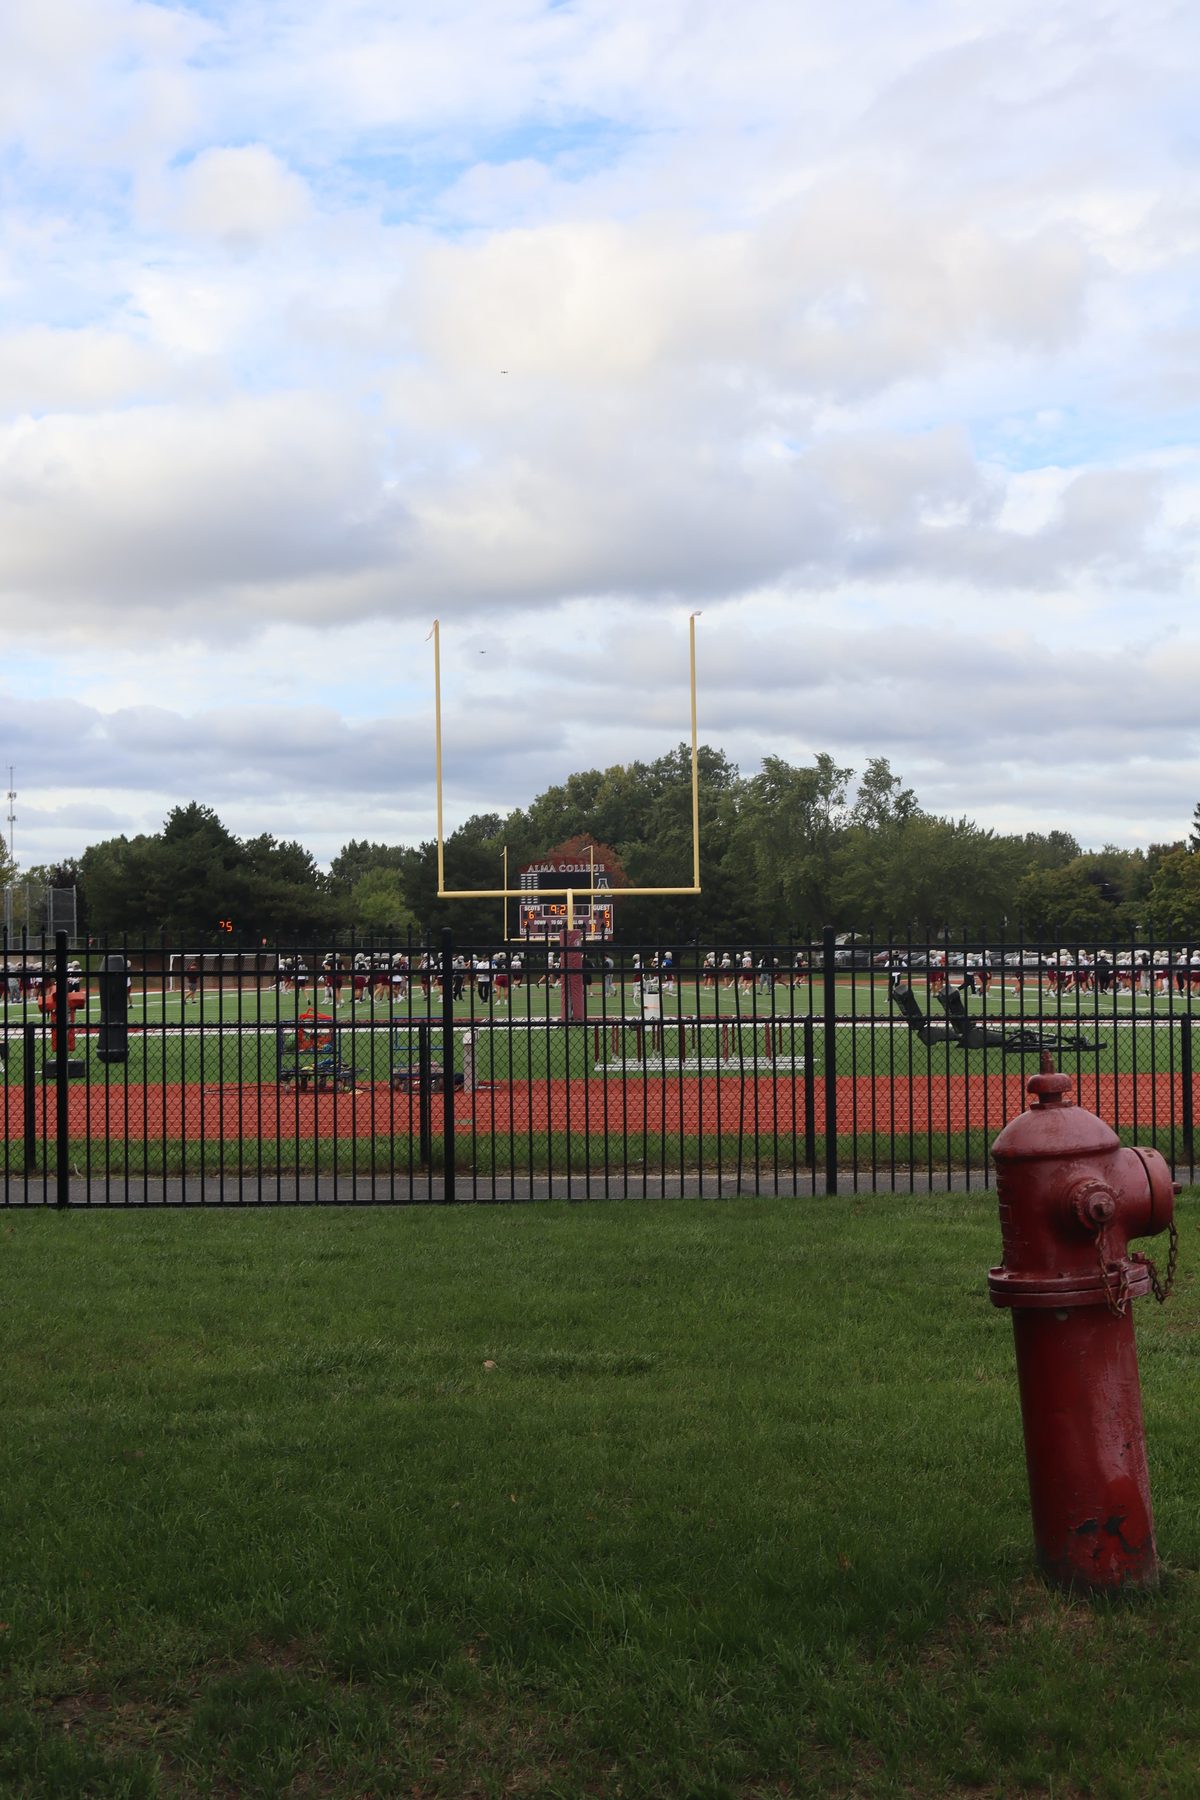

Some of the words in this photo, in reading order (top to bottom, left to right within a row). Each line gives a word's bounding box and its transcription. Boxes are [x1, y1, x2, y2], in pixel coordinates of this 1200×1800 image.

[527, 864, 556, 873] ALMA
[559, 864, 605, 873] COLLEGE
[550, 904, 569, 915] 9:2
[528, 911, 535, 920] 6
[604, 910, 610, 919] 6
